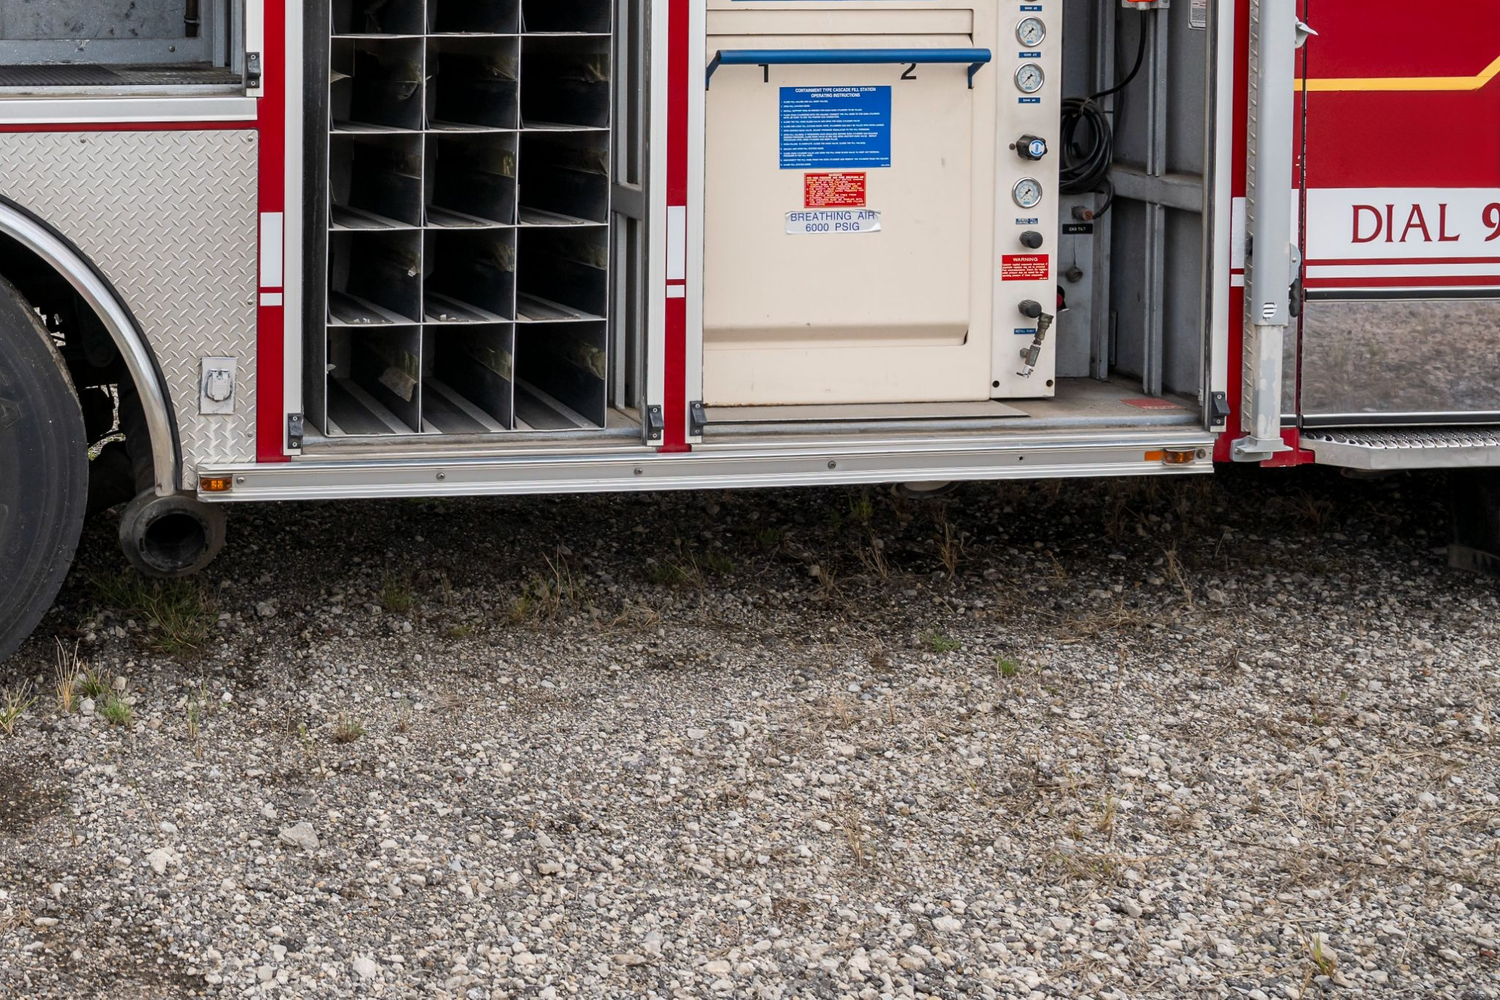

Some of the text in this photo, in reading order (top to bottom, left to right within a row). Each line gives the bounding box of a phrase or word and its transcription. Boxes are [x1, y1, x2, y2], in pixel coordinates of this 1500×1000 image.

[758, 64, 769, 83] 1
[900, 62, 917, 80] 2
[790, 210, 875, 221] BREATHING AIR
[1351, 203, 1460, 243] DIAL
[805, 222, 860, 232] 6000 PSIG
